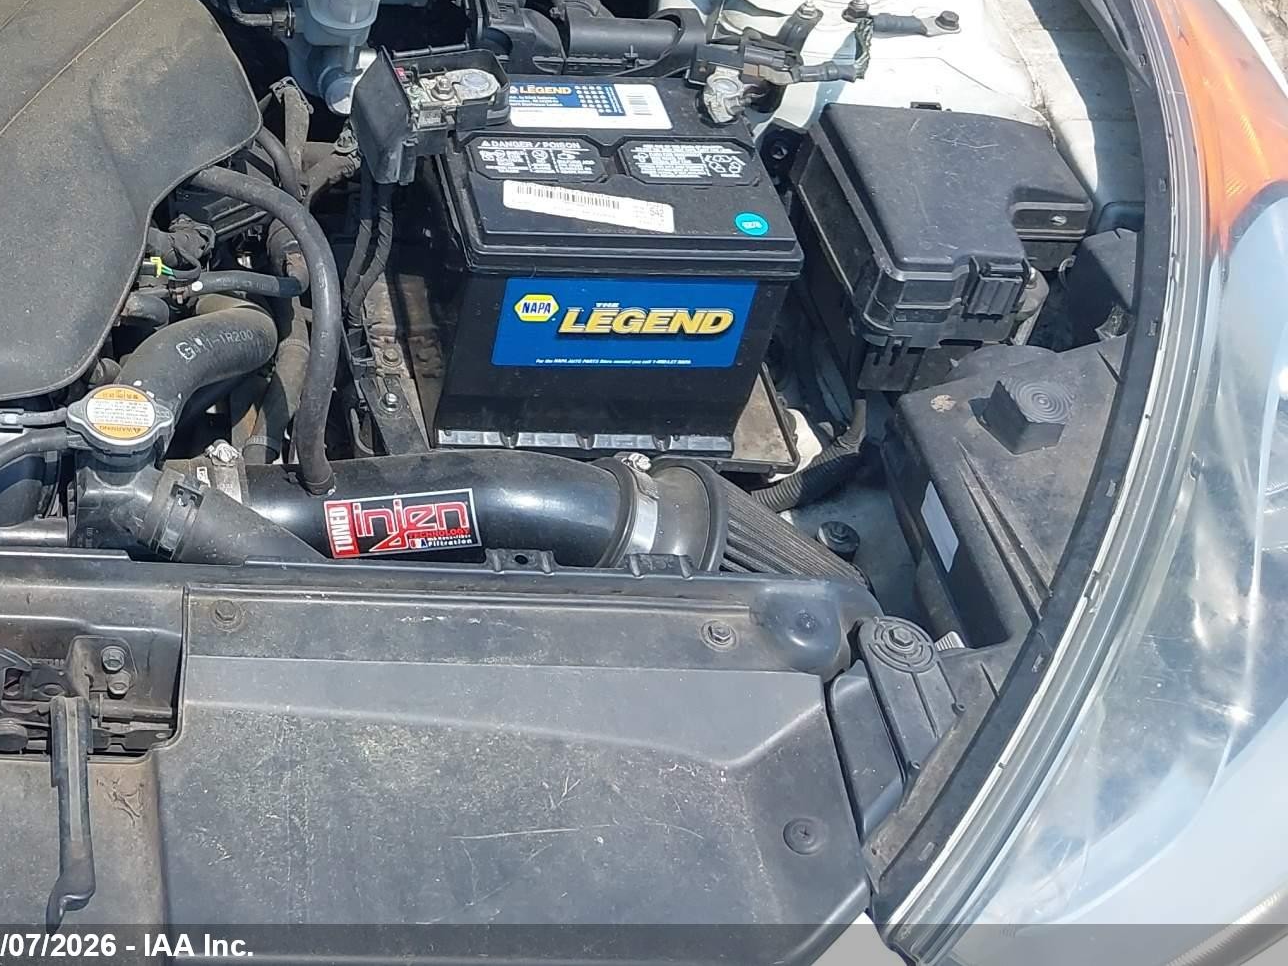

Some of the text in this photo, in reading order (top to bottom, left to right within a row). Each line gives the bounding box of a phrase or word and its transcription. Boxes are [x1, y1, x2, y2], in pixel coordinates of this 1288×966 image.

[491, 140, 534, 149] DANGER
[542, 141, 581, 150] POISON
[521, 301, 552, 315] NAPA
[328, 506, 355, 553] TUNED
[353, 499, 470, 552] injen
